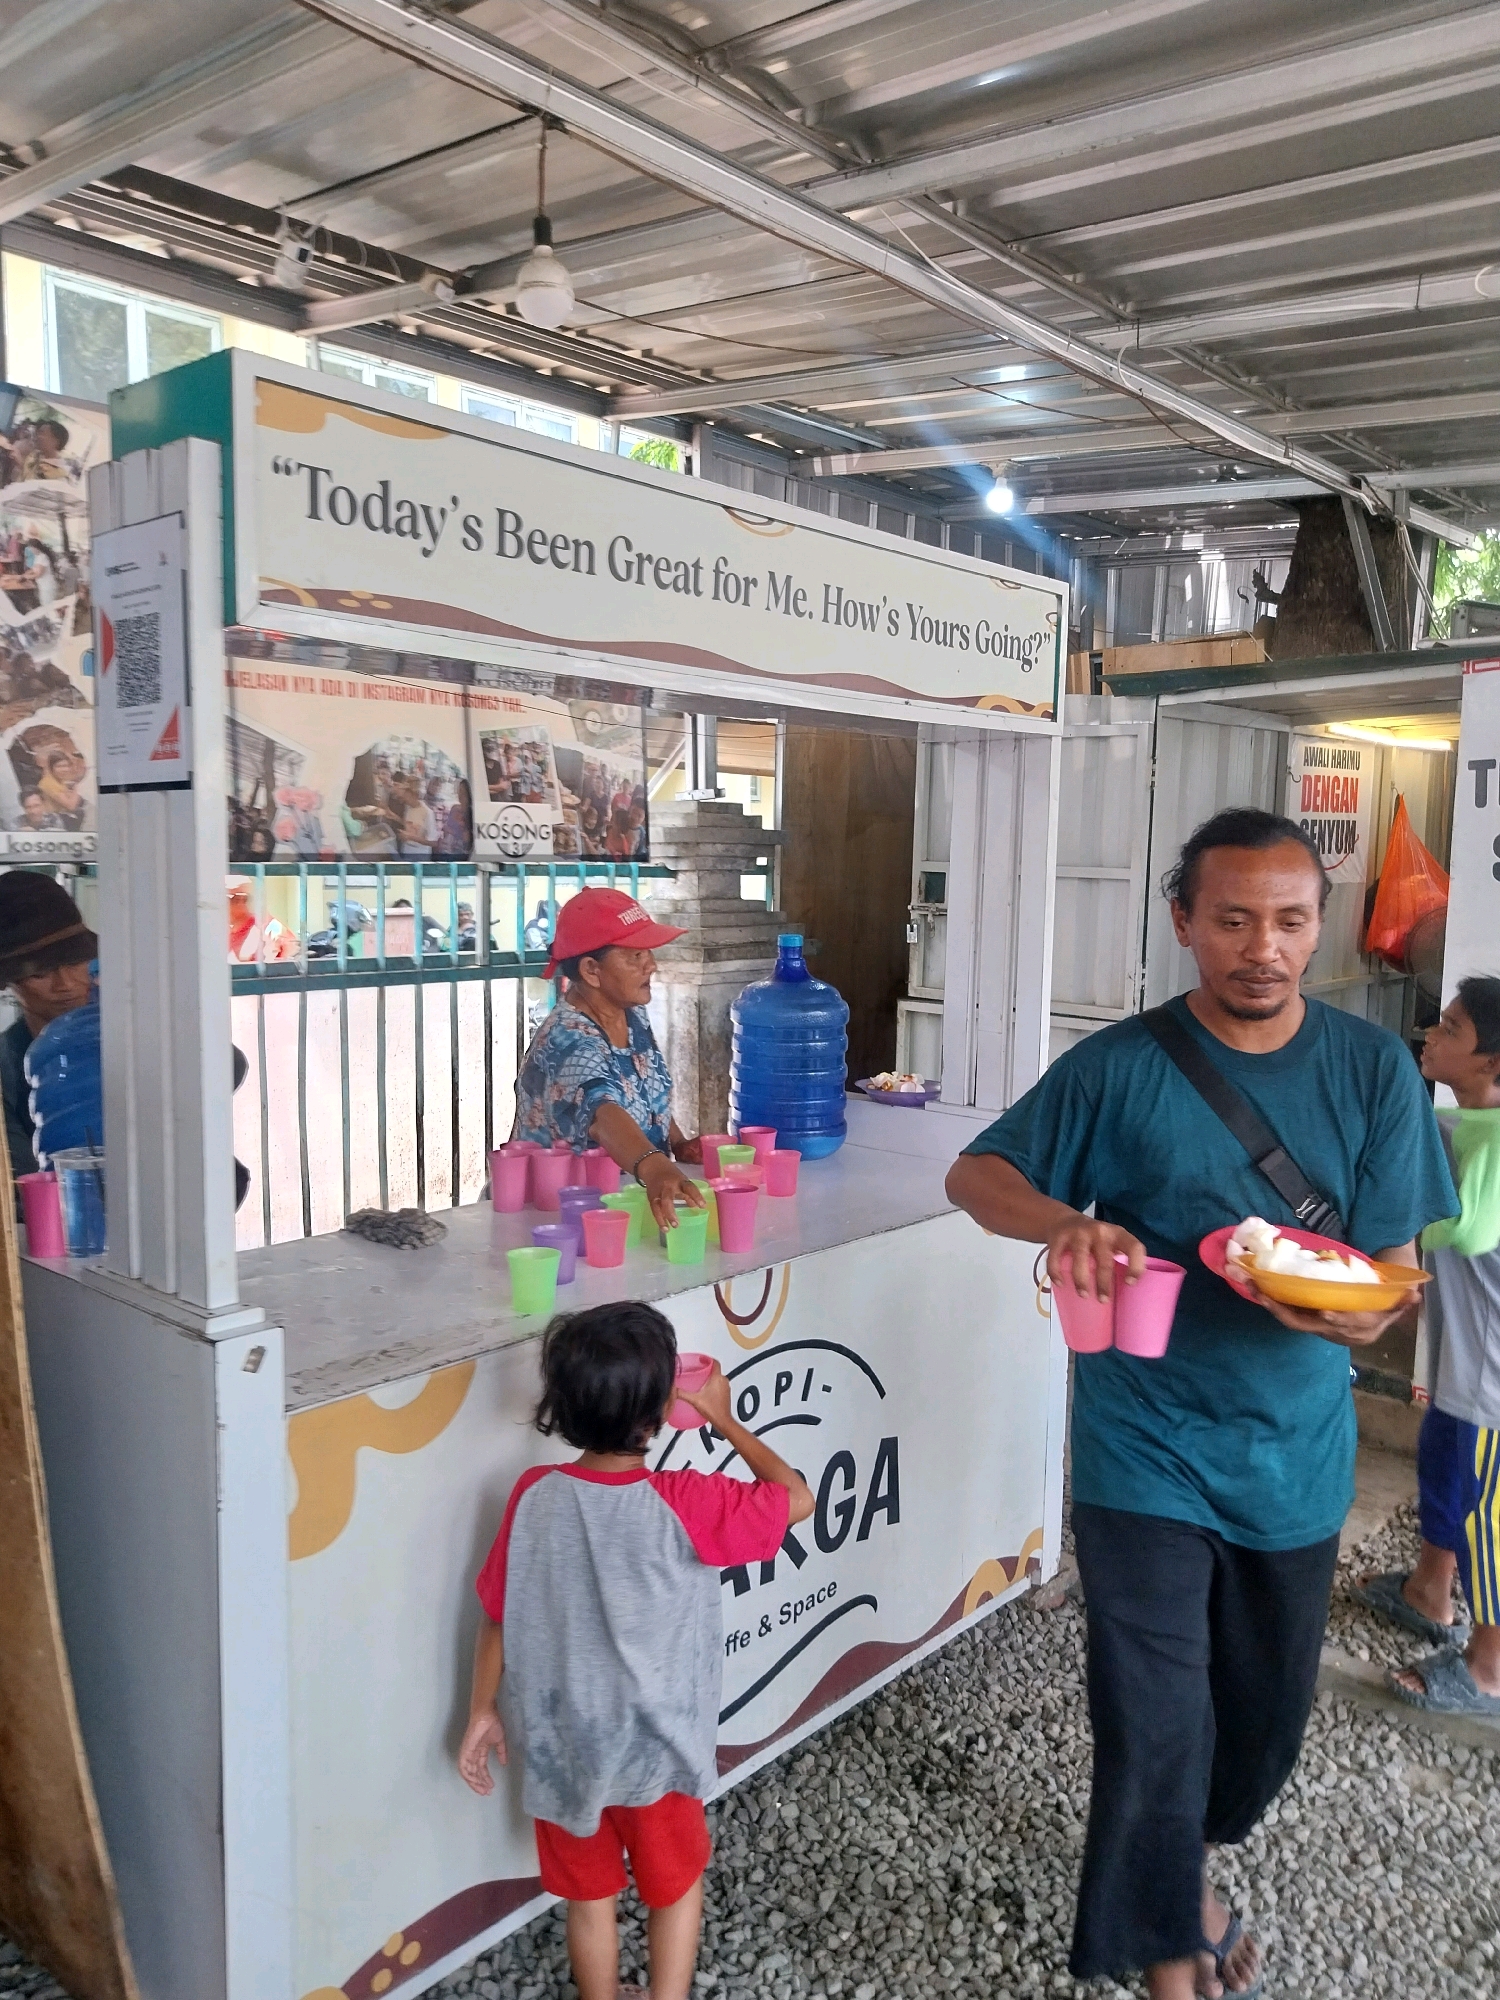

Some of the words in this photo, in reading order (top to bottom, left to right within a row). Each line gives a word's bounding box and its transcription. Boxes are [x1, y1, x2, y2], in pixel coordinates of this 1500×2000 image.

[495, 506, 598, 576] Been
[608, 535, 704, 597] Great
[711, 556, 758, 606] for
[765, 570, 815, 621] Me.
[906, 602, 970, 651] Yours
[1303, 746, 1330, 770] AWALI
[1330, 749, 1361, 771] HARIMU
[1301, 774, 1359, 813] DENGAN
[476, 822, 551, 840] KOSONG
[758, 1614, 772, 1638] &
[779, 1581, 837, 1625] Space
